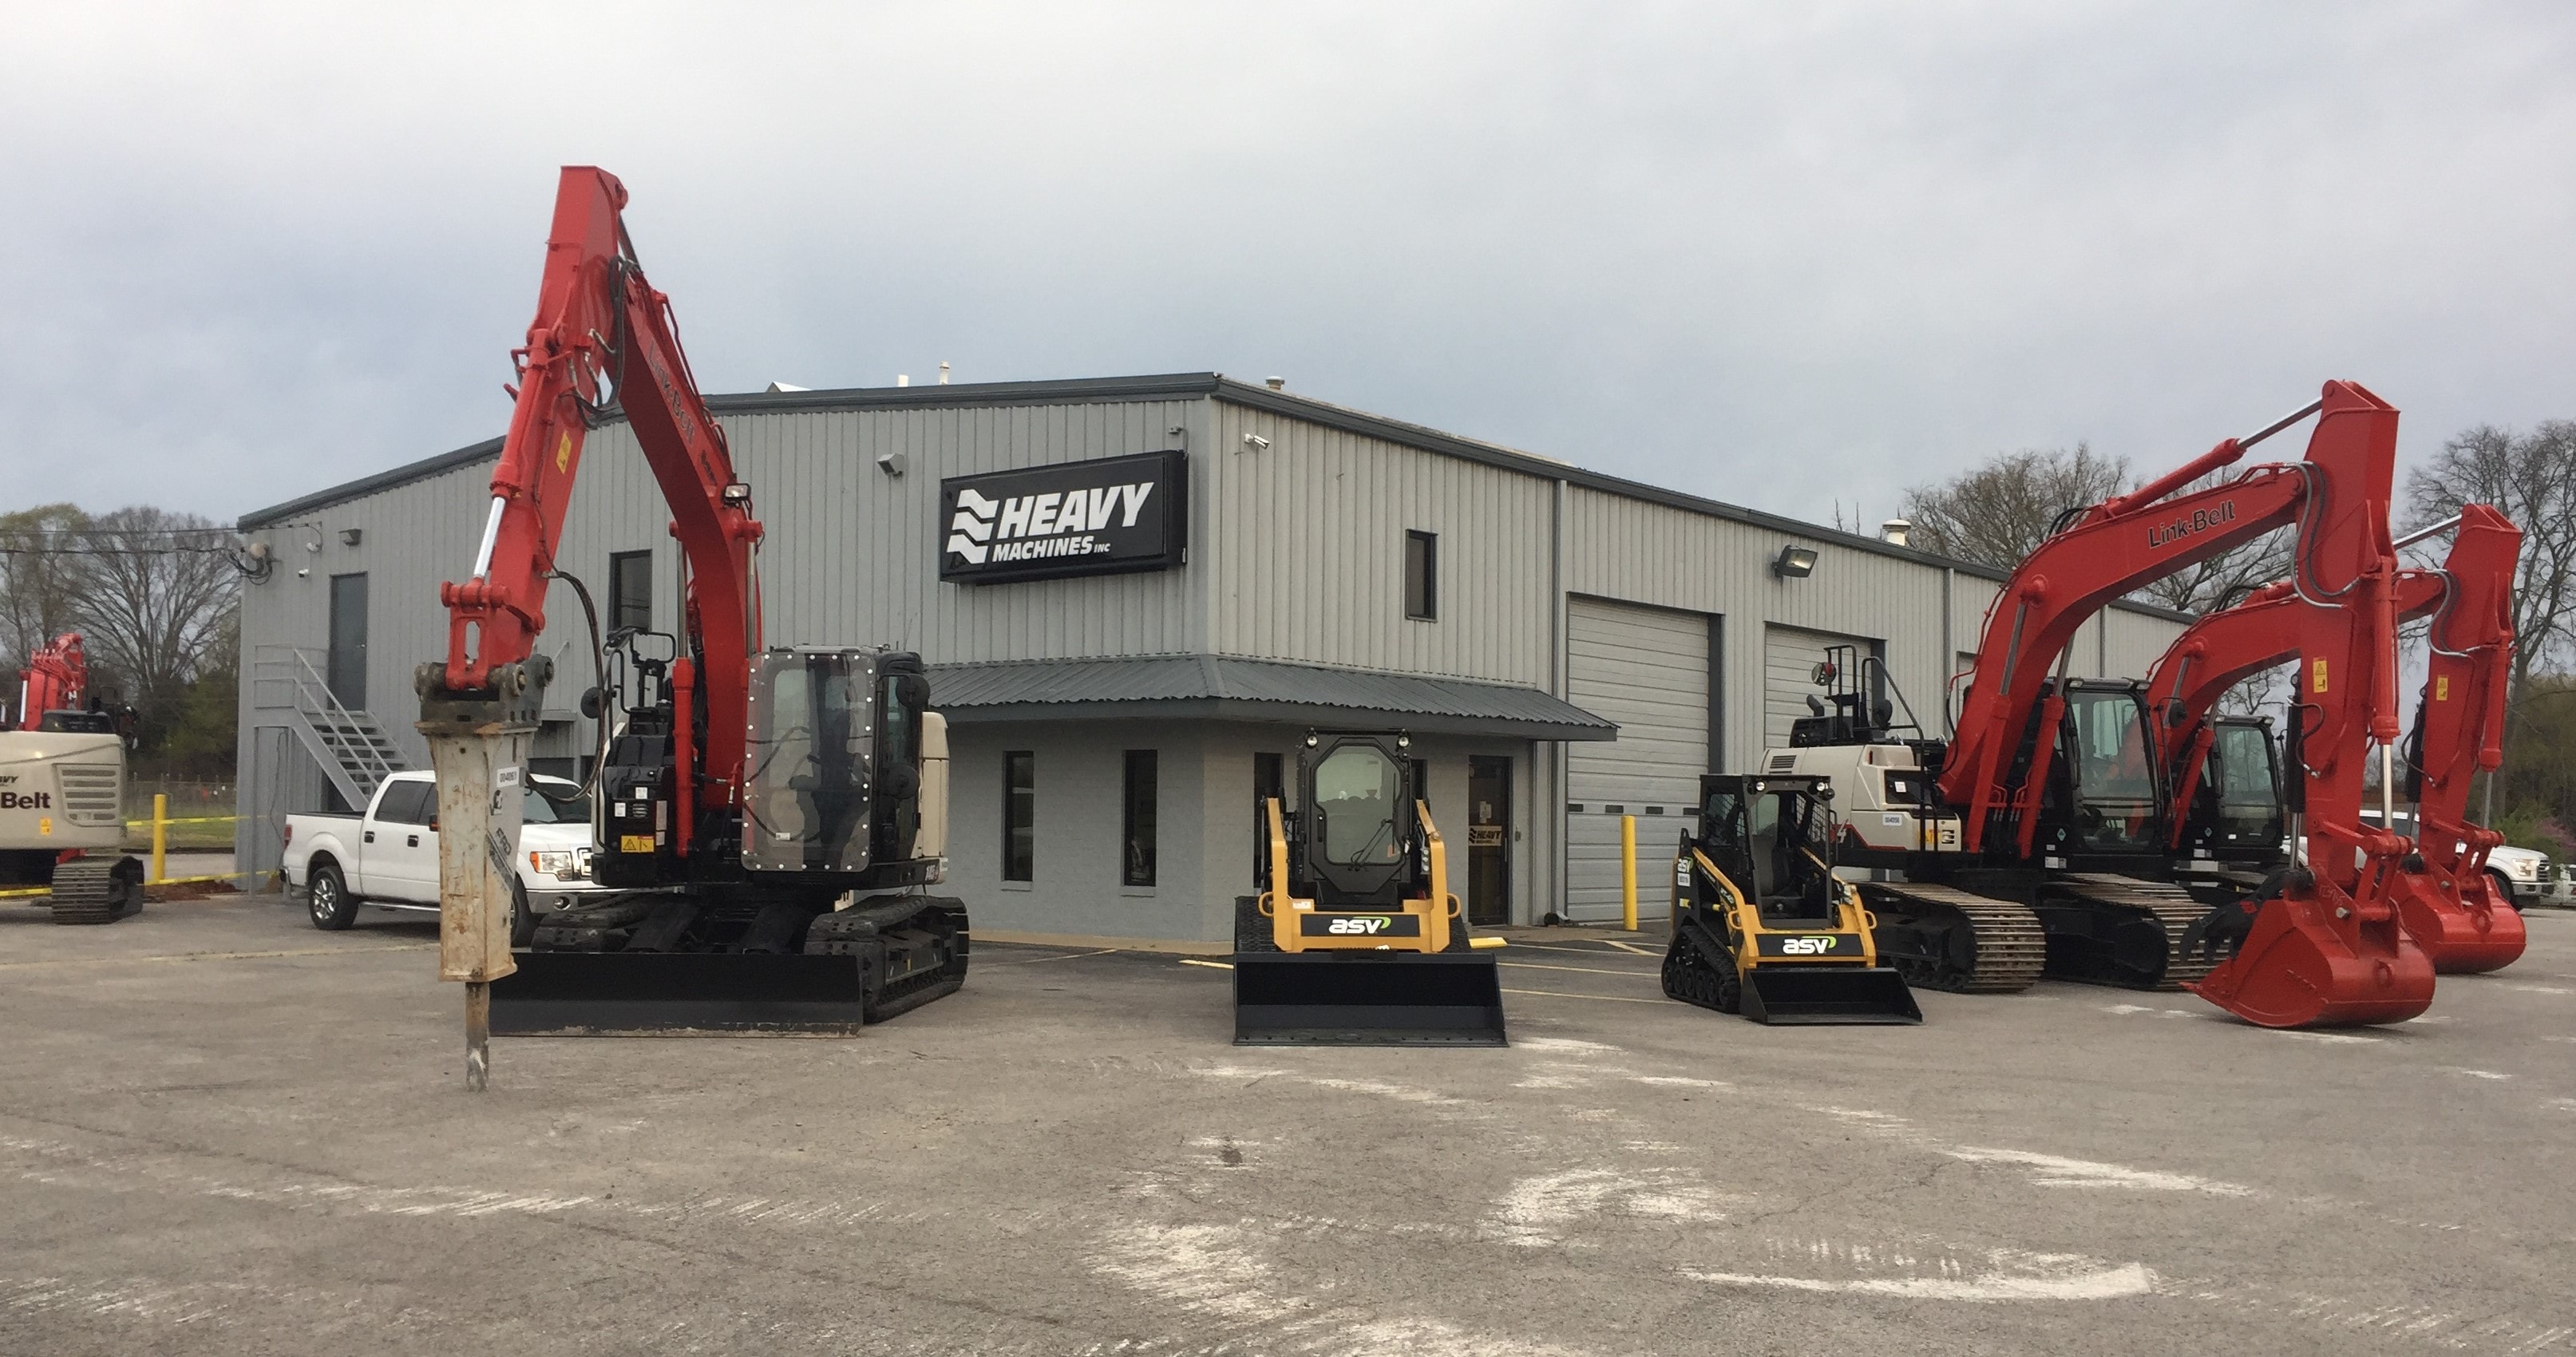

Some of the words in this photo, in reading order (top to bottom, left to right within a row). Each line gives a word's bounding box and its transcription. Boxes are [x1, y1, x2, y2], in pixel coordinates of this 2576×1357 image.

[997, 481, 1154, 540] HEAVY
[2148, 500, 2236, 549] Link-Belt
[992, 535, 1094, 562] MACHINES
[1094, 542, 1111, 553] INC
